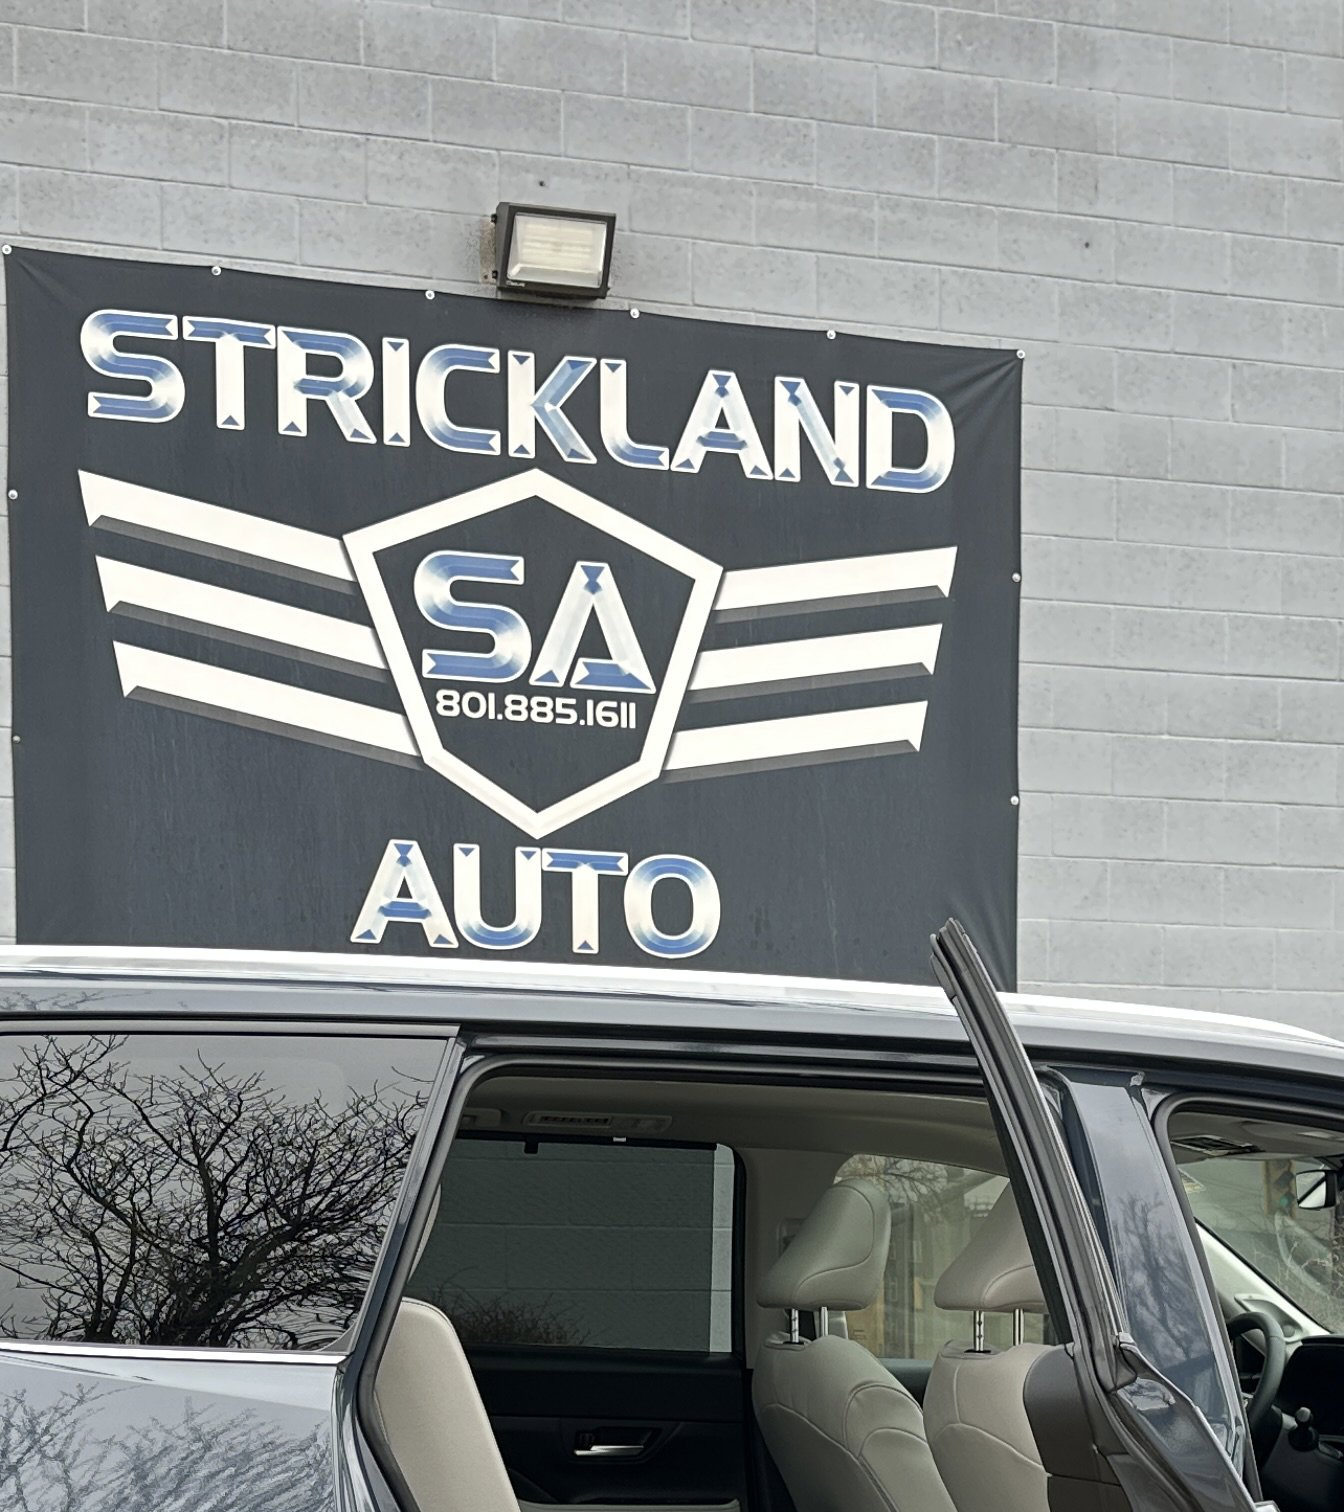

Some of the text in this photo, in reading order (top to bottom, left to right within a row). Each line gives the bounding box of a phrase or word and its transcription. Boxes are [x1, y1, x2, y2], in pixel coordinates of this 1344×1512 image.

[79, 308, 957, 494] STRICKLAND
[413, 549, 656, 694] SA
[435, 688, 637, 729] 801.885.1611
[350, 838, 721, 959] AUTO
